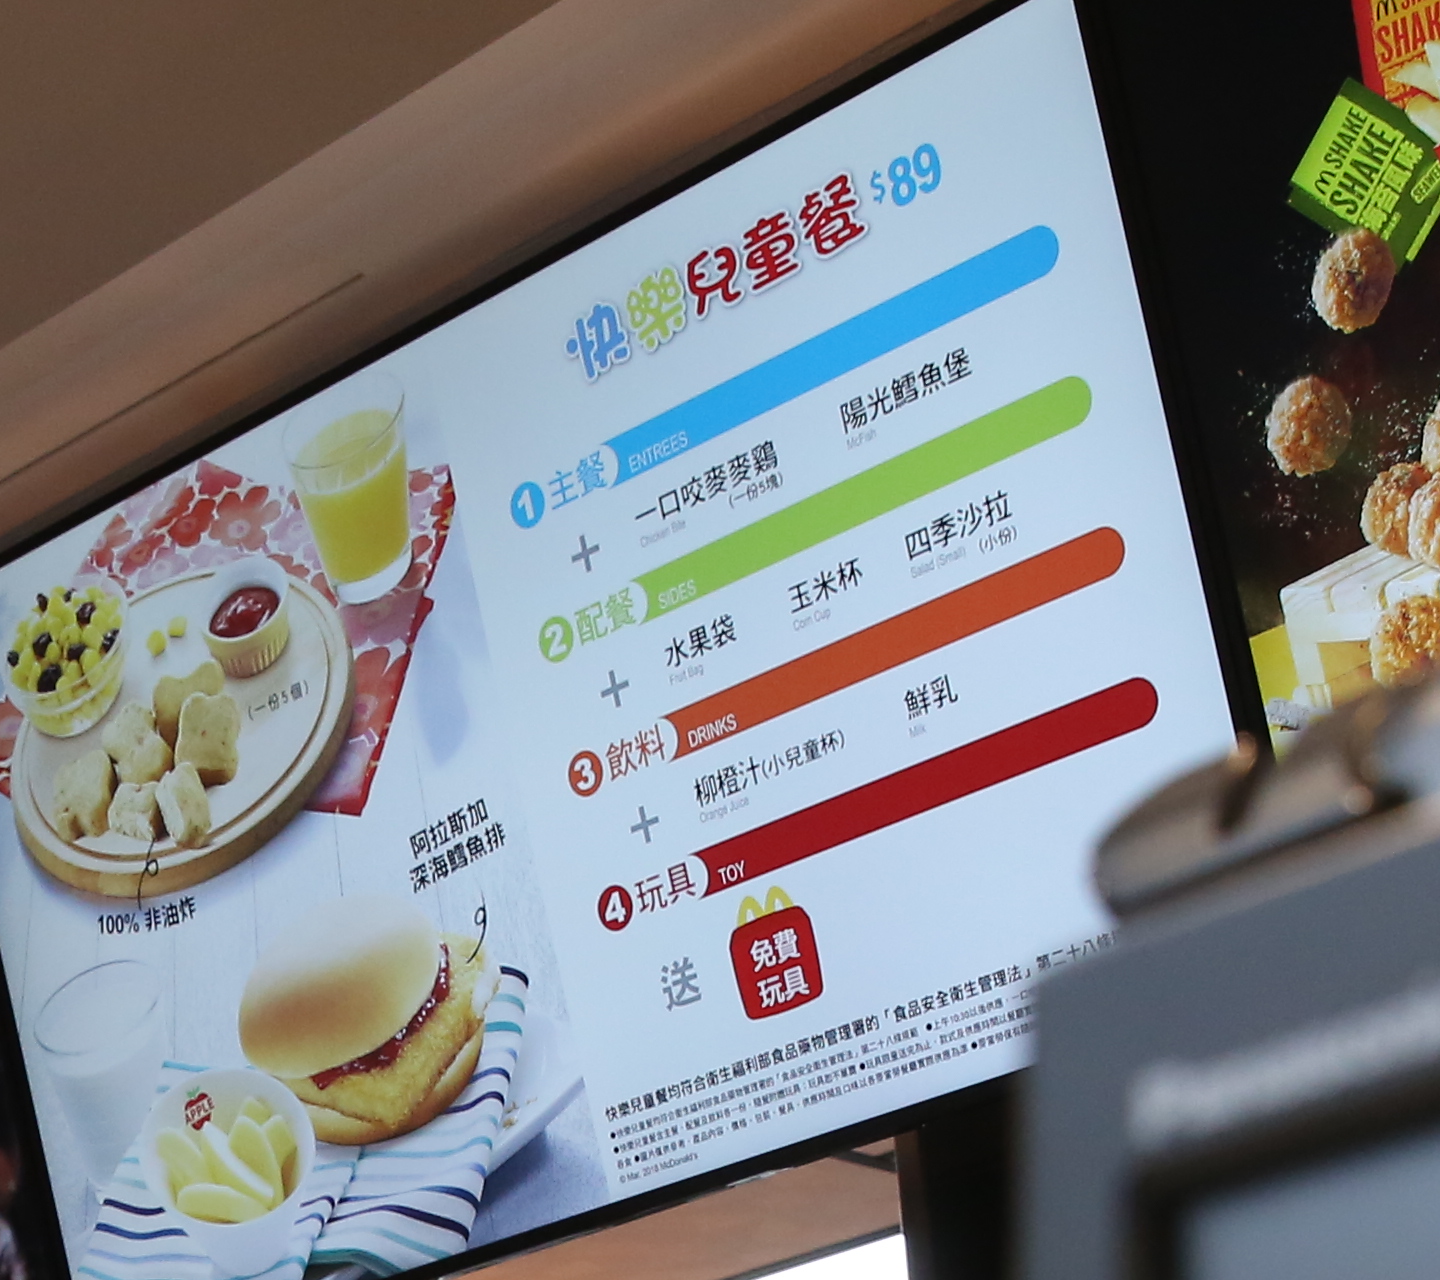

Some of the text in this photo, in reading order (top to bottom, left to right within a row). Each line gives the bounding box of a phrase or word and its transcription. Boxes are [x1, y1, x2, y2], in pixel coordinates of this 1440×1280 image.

[1324, 106, 1368, 169] SHAKE
[1329, 122, 1397, 216] SHAKE
[565, 143, 942, 380] 快樂兒童餐 $89
[839, 347, 973, 434] 陽光鱈魚堡
[548, 450, 609, 510] 主餐
[628, 431, 688, 473] ENTREES
[903, 490, 1012, 561] 四季沙拉
[978, 525, 1017, 554] (小份)
[574, 586, 638, 646] 配餐
[658, 579, 698, 610] SIDES
[788, 557, 863, 614] 玉米杯
[664, 613, 738, 669] 水果袋
[903, 674, 958, 720] 鮮乳
[605, 723, 666, 782] 飲料
[687, 714, 738, 750] DRINKS
[409, 798, 489, 859] 阿拉斯加
[409, 823, 506, 893] 深海鱈魚排
[97, 895, 197, 935] 100% 非油炸
[635, 861, 697, 914] 玩具
[718, 861, 745, 884] TOY
[750, 928, 801, 972] 免費
[661, 957, 702, 1011] 送
[756, 965, 810, 1009] 玩具
[185, 1097, 215, 1126] APPLE
